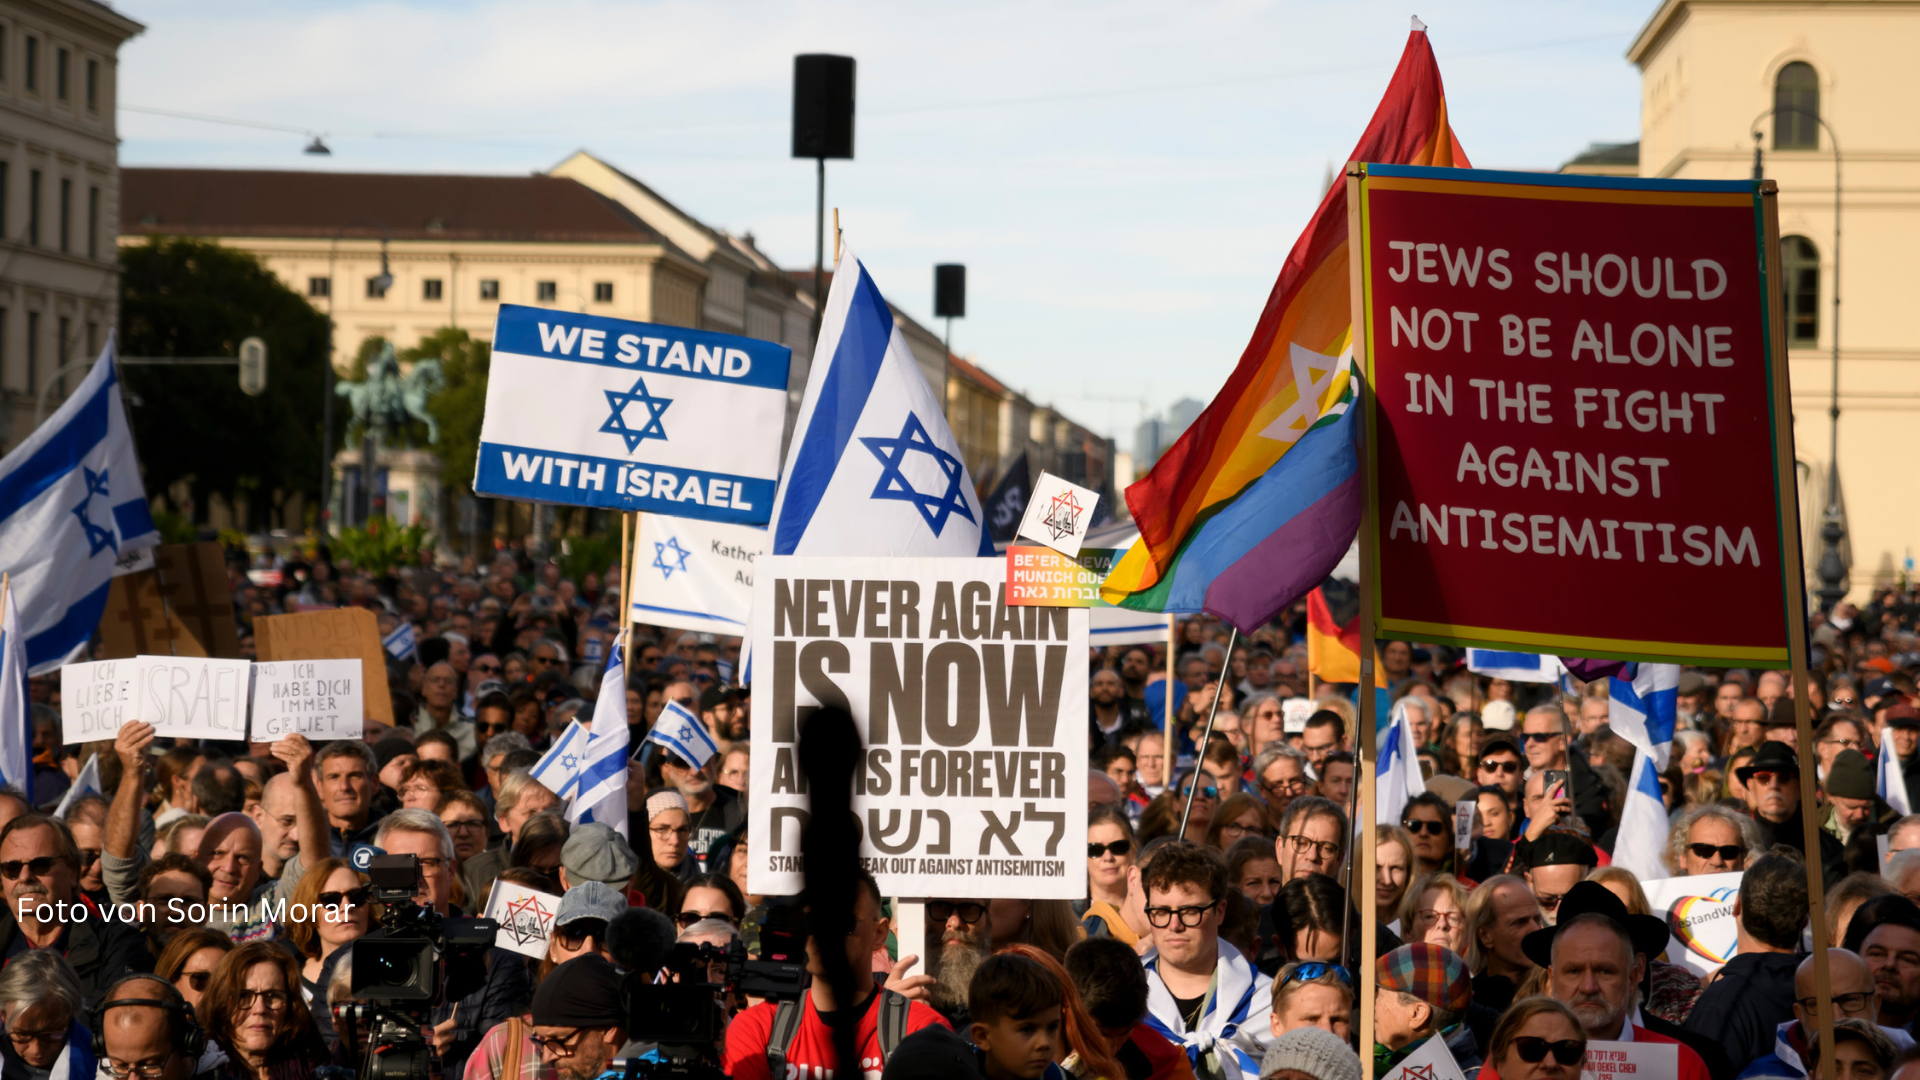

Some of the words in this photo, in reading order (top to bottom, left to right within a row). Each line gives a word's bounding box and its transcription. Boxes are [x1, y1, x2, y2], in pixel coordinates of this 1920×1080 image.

[1388, 240, 1513, 290] JEWS
[1534, 251, 1728, 300] SHOULD
[538, 322, 606, 359] WE
[615, 334, 751, 378] STAND
[1390, 305, 1479, 353] NOT
[1500, 314, 1553, 358] BE
[1571, 319, 1734, 367] ALONE
[1405, 372, 1453, 416] IN
[1469, 378, 1553, 424] THE
[1574, 387, 1725, 435] FIGHT
[501, 451, 606, 491] WITH
[616, 466, 752, 511] ISRAEL
[1457, 441, 1670, 499] AGAINST
[1389, 500, 1761, 567] ANTISEMITISM
[711, 539, 763, 563] Katho
[1014, 555, 1059, 567] BE'ER
[1064, 555, 1112, 569] SHEVA
[734, 570, 753, 587] Au
[1013, 585, 1048, 598] גאה
[1014, 570, 1073, 583] MUNICH
[1077, 571, 1112, 585] QUE
[774, 578, 920, 639] NEVER
[929, 581, 1068, 641] AGAIN
[92, 662, 115, 682] ICH
[292, 663, 315, 679] ICH
[76, 680, 129, 708] LIEBE
[138, 664, 245, 733] ISRAEL
[272, 681, 310, 699] HABE
[317, 678, 350, 697] DICH
[772, 640, 851, 744] IS
[869, 641, 1068, 747] NOW
[281, 697, 337, 712] IMMER
[80, 705, 124, 734] DICH
[266, 715, 338, 735] GELIET
[856, 748, 892, 796] IS
[900, 749, 1065, 798] FOREVER
[978, 802, 1066, 857] לא
[769, 856, 805, 873] STAN
[858, 857, 888, 874] PEAK
[891, 858, 916, 874] OUT
[919, 858, 973, 875] AGAINST
[975, 859, 1065, 877] ANTISEMITISM
[1597, 1062, 1617, 1072] DEKEL
[1619, 1063, 1636, 1074] CHEN
